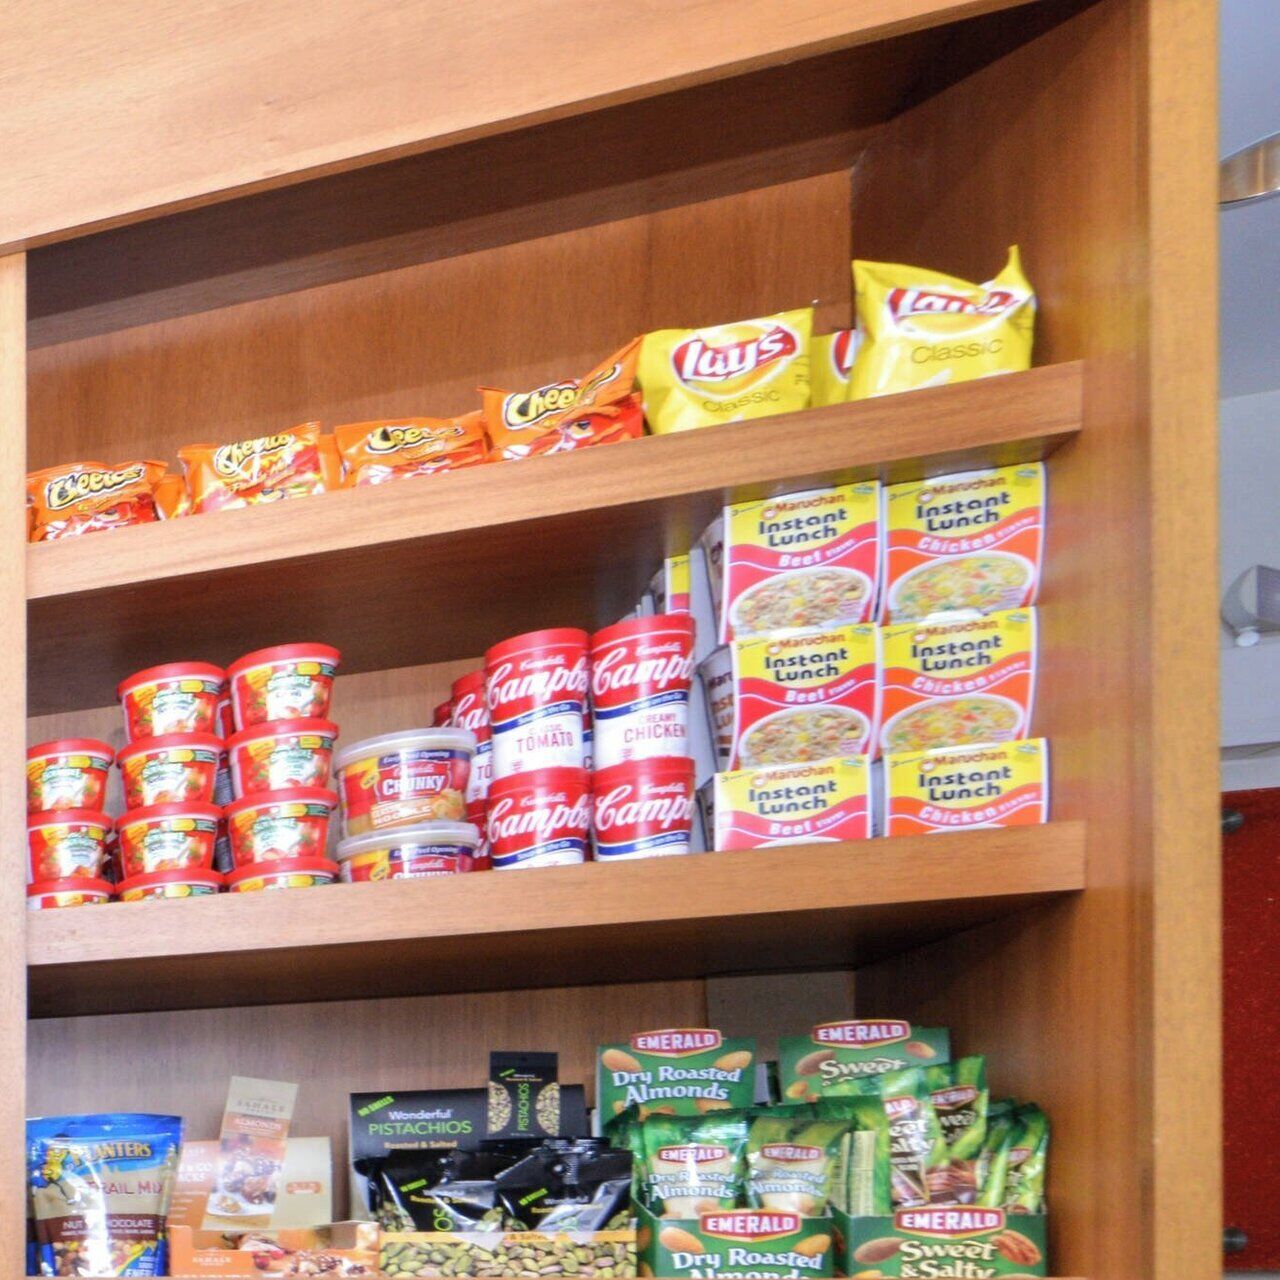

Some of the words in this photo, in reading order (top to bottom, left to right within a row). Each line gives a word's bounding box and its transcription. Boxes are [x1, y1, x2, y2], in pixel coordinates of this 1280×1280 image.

[682, 331, 787, 384] Lay's
[911, 339, 1004, 364] Classic
[703, 390, 781, 413] Classic
[930, 475, 1005, 495] Maruchan
[774, 493, 845, 513] Maruchan
[915, 491, 1011, 520] Instant
[759, 508, 848, 534] Instant
[927, 511, 1001, 532] Lunch
[768, 526, 838, 548] Lunch
[917, 532, 995, 551] Chicken
[779, 550, 821, 567] Beef
[925, 620, 999, 636] Maruchan
[778, 632, 845, 648] Maruchan
[911, 635, 1002, 658] Instant
[765, 648, 848, 674] Instant
[920, 653, 991, 673] Lunch
[774, 665, 839, 684] Lunch
[784, 687, 824, 702] Beef
[913, 675, 987, 695] Chicken
[516, 731, 574, 753] TOMATO
[624, 723, 687, 744] CHICKEN
[930, 750, 1007, 766] Maruchan
[765, 766, 834, 784] Maruchan
[919, 765, 1012, 789] Instant
[749, 781, 837, 802] Instant
[928, 784, 1002, 802] Lunch
[758, 797, 828, 816] Lunch
[919, 802, 993, 826] Chicken
[769, 820, 814, 837] Beef
[637, 1033, 717, 1050] EMERALD
[818, 1023, 904, 1043] EMERALD
[613, 1071, 652, 1092] Dry
[659, 1066, 740, 1087] Roasted
[820, 1058, 907, 1080] Sweet
[625, 1084, 728, 1108] Almonds
[389, 1109, 453, 1121] Wonderful
[368, 1120, 473, 1137] PISTACHIOS
[661, 1147, 724, 1161] EMERALD
[653, 1186, 744, 1202] Almonds
[707, 1216, 795, 1235] EMERALD
[901, 1213, 999, 1233] EMERALD
[899, 1239, 998, 1262] Sweet
[672, 1251, 720, 1275] Dry
[729, 1248, 824, 1272] Roasted
